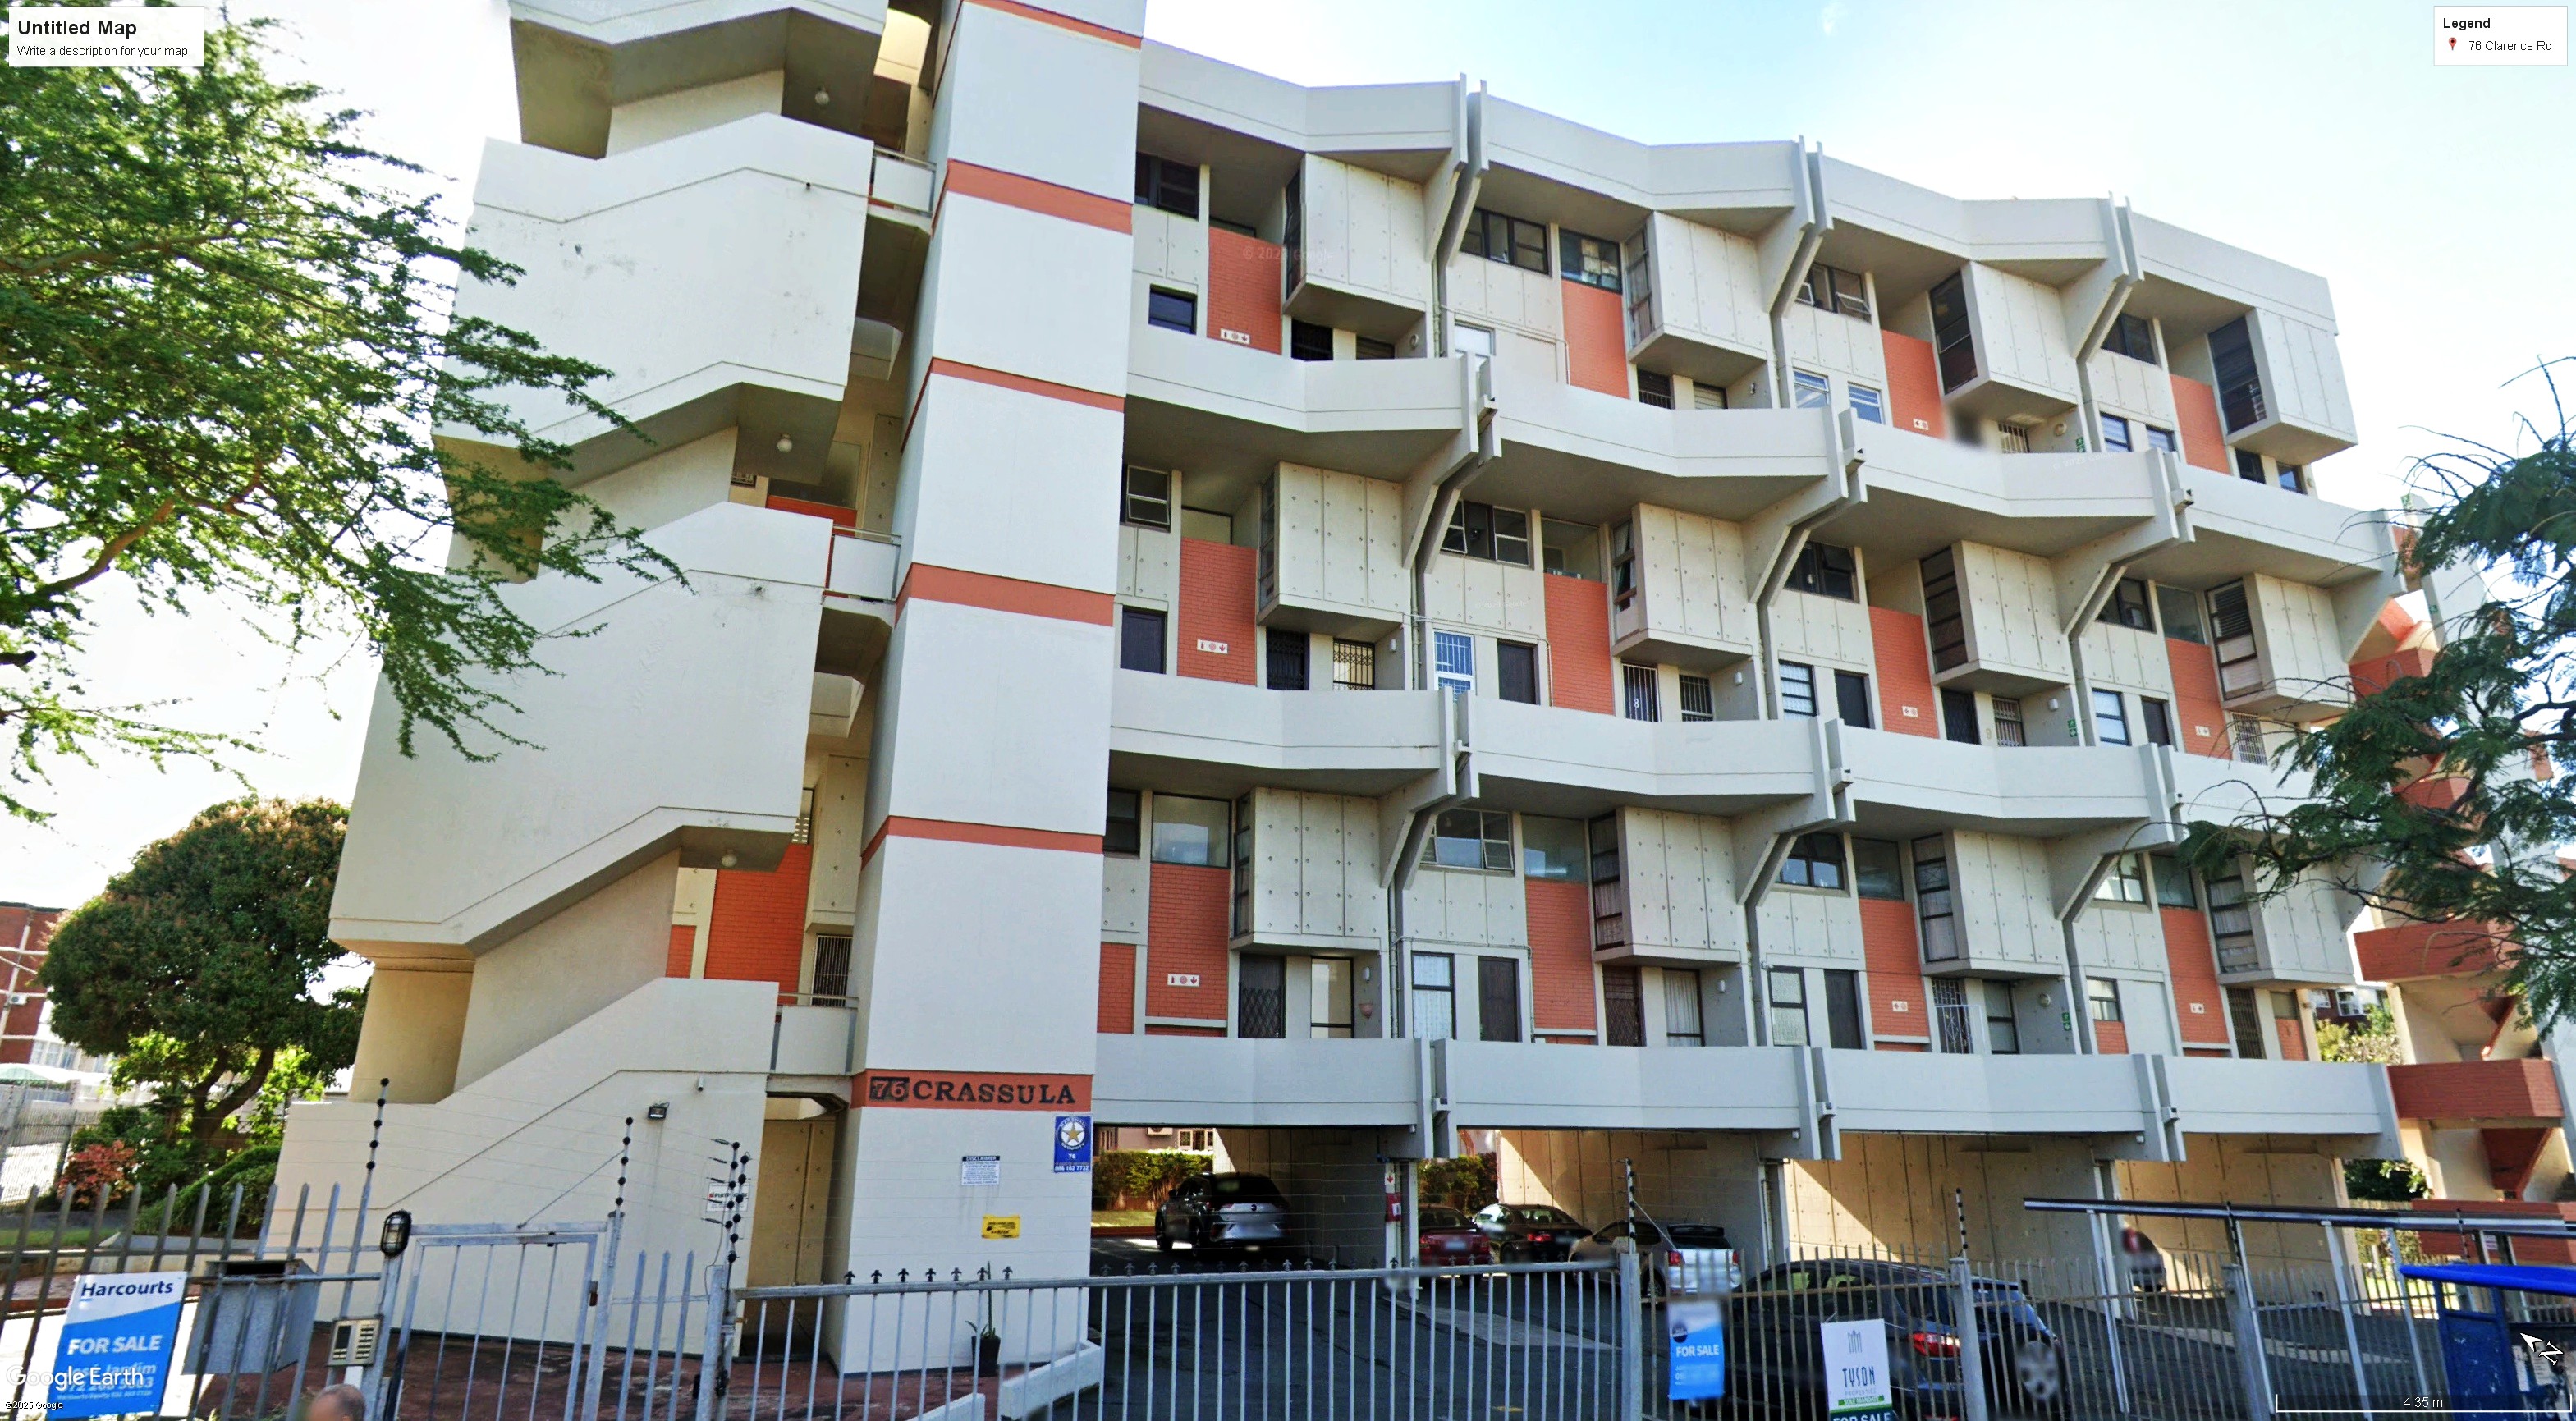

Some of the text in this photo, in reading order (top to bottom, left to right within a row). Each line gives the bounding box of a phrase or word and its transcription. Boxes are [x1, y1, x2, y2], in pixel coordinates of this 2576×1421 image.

[1634, 698, 1640, 708] 8
[870, 1079, 1076, 1105] 76 CRASSULA
[80, 1281, 174, 1297] Harcourts
[67, 1334, 163, 1355] FOR SALE
[1676, 1345, 1720, 1357] FOR SALE
[1842, 1366, 1876, 1388] TYSON
